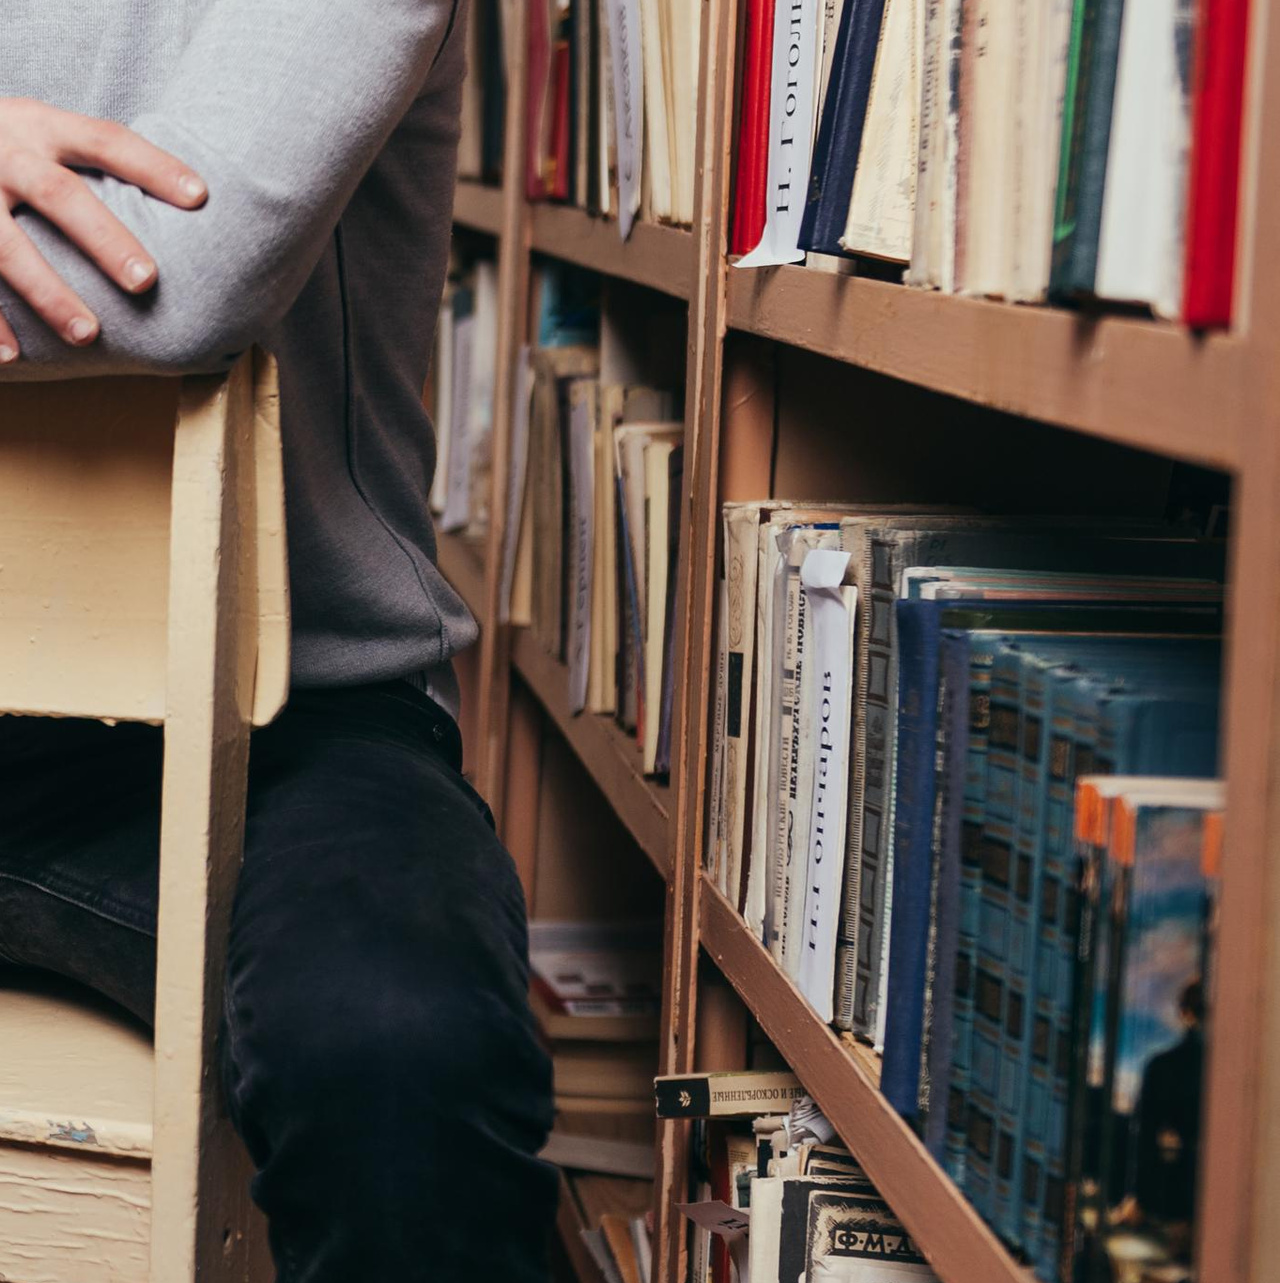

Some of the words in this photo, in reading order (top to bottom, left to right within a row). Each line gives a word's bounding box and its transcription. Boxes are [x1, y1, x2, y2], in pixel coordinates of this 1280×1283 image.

[796, 581, 808, 654] ПОВЕСТ
[779, 737, 790, 791] ПОВЕСТИ
[775, 799, 787, 898] ПЕТЕРБУРГСКИЕ
[712, 1088, 780, 1104] ОСКОРБЛЕННЫЕ
